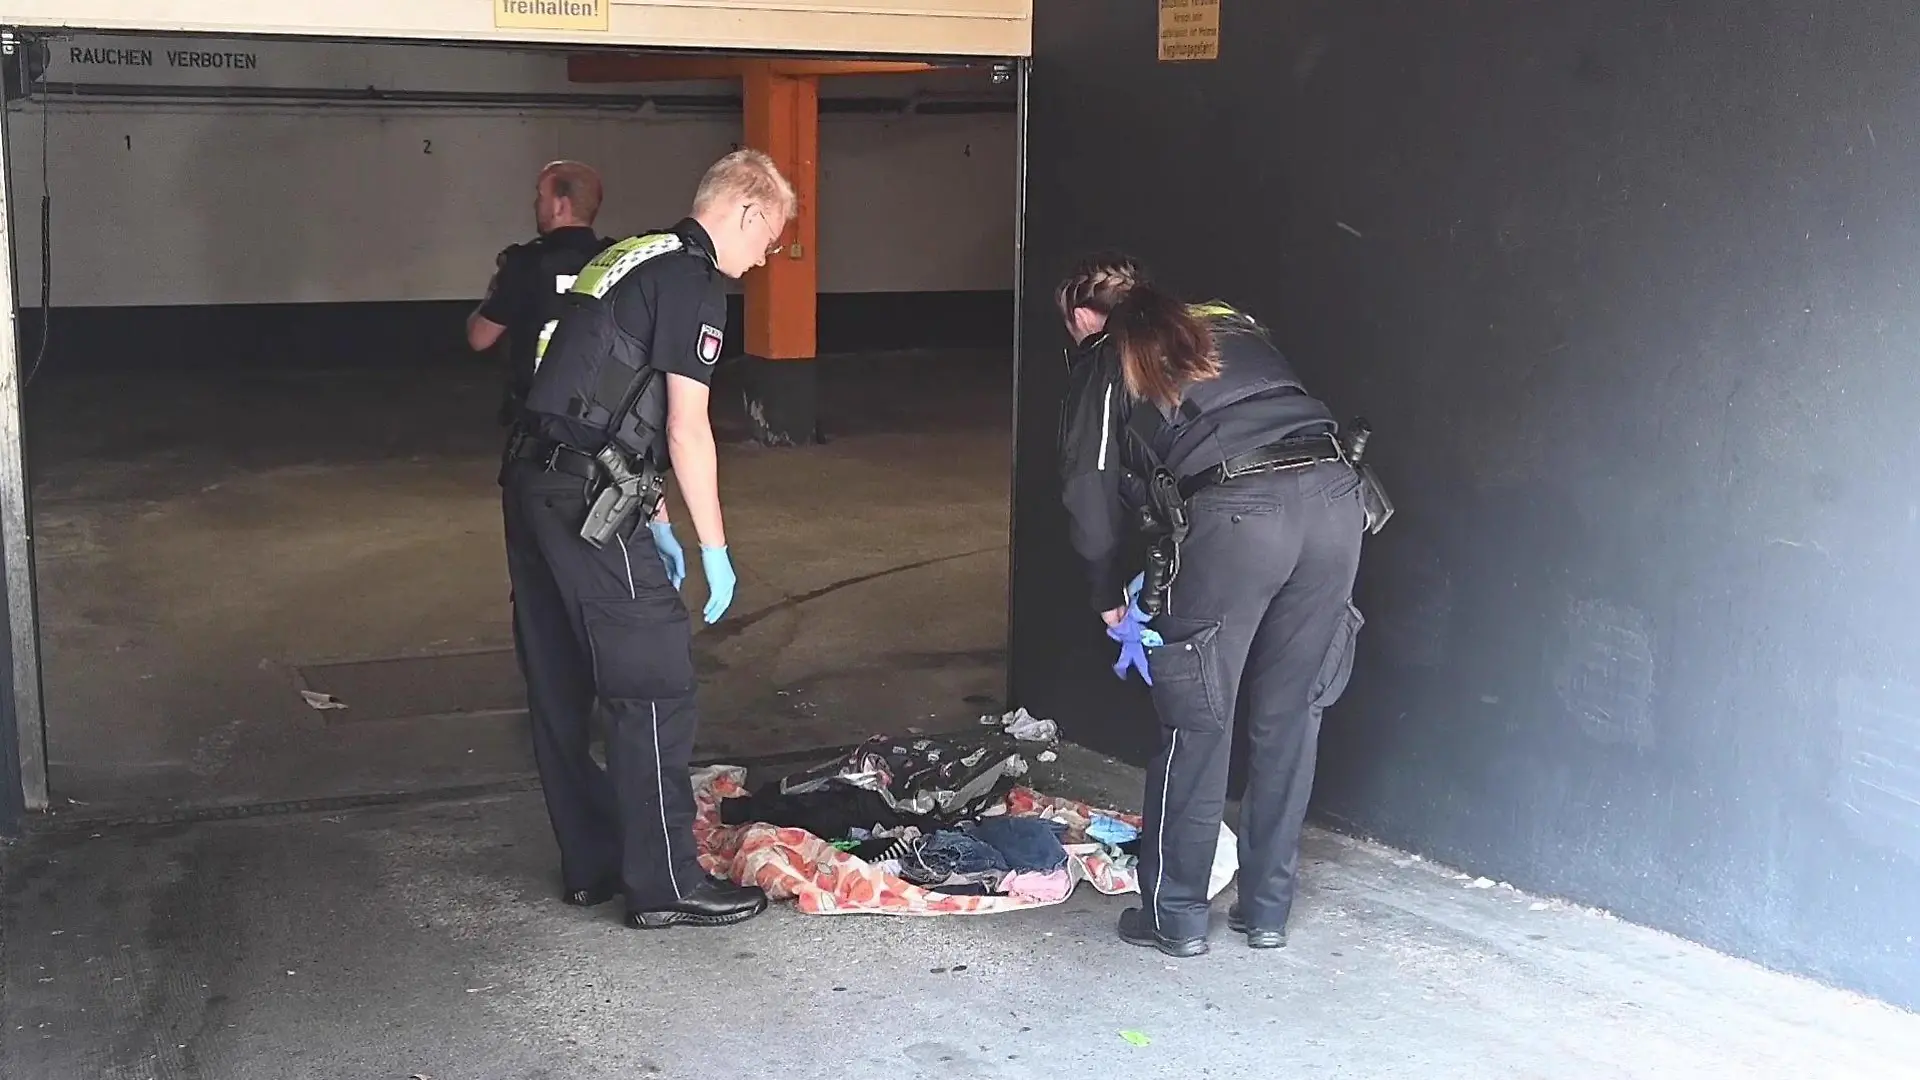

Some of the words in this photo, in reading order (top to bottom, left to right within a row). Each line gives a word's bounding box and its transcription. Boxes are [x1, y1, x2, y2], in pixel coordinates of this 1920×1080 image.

[503, 0, 599, 16] freihalten!
[70, 47, 153, 66] RAUCHEN
[166, 51, 257, 69] VERBOTEN
[124, 134, 131, 151] 1
[423, 139, 432, 154] 2
